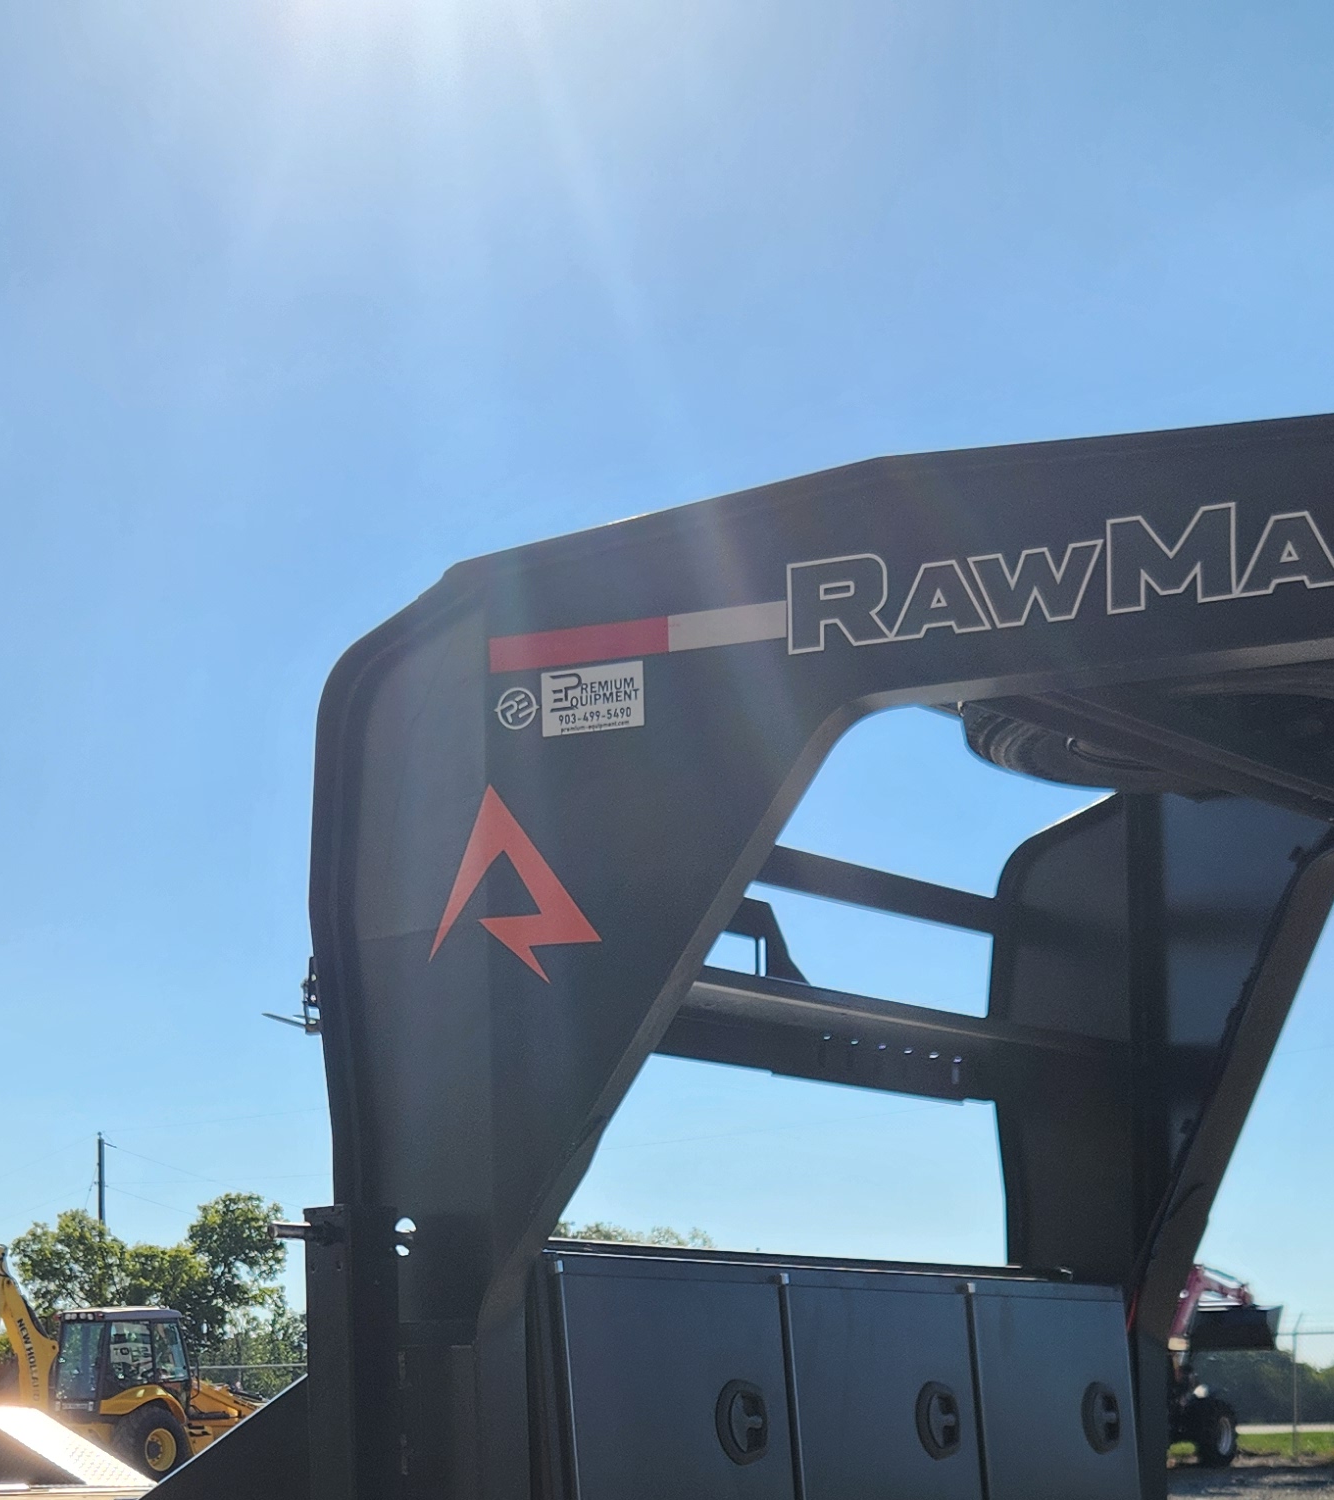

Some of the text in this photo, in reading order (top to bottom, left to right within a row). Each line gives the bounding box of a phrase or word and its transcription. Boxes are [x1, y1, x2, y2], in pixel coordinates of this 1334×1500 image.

[550, 672, 635, 702] PREMIUM
[550, 688, 640, 713] EQUIPMENT
[558, 707, 632, 726] 903-499-5490
[560, 719, 630, 734] premium-equipment.com
[17, 1318, 31, 1345] NEW
